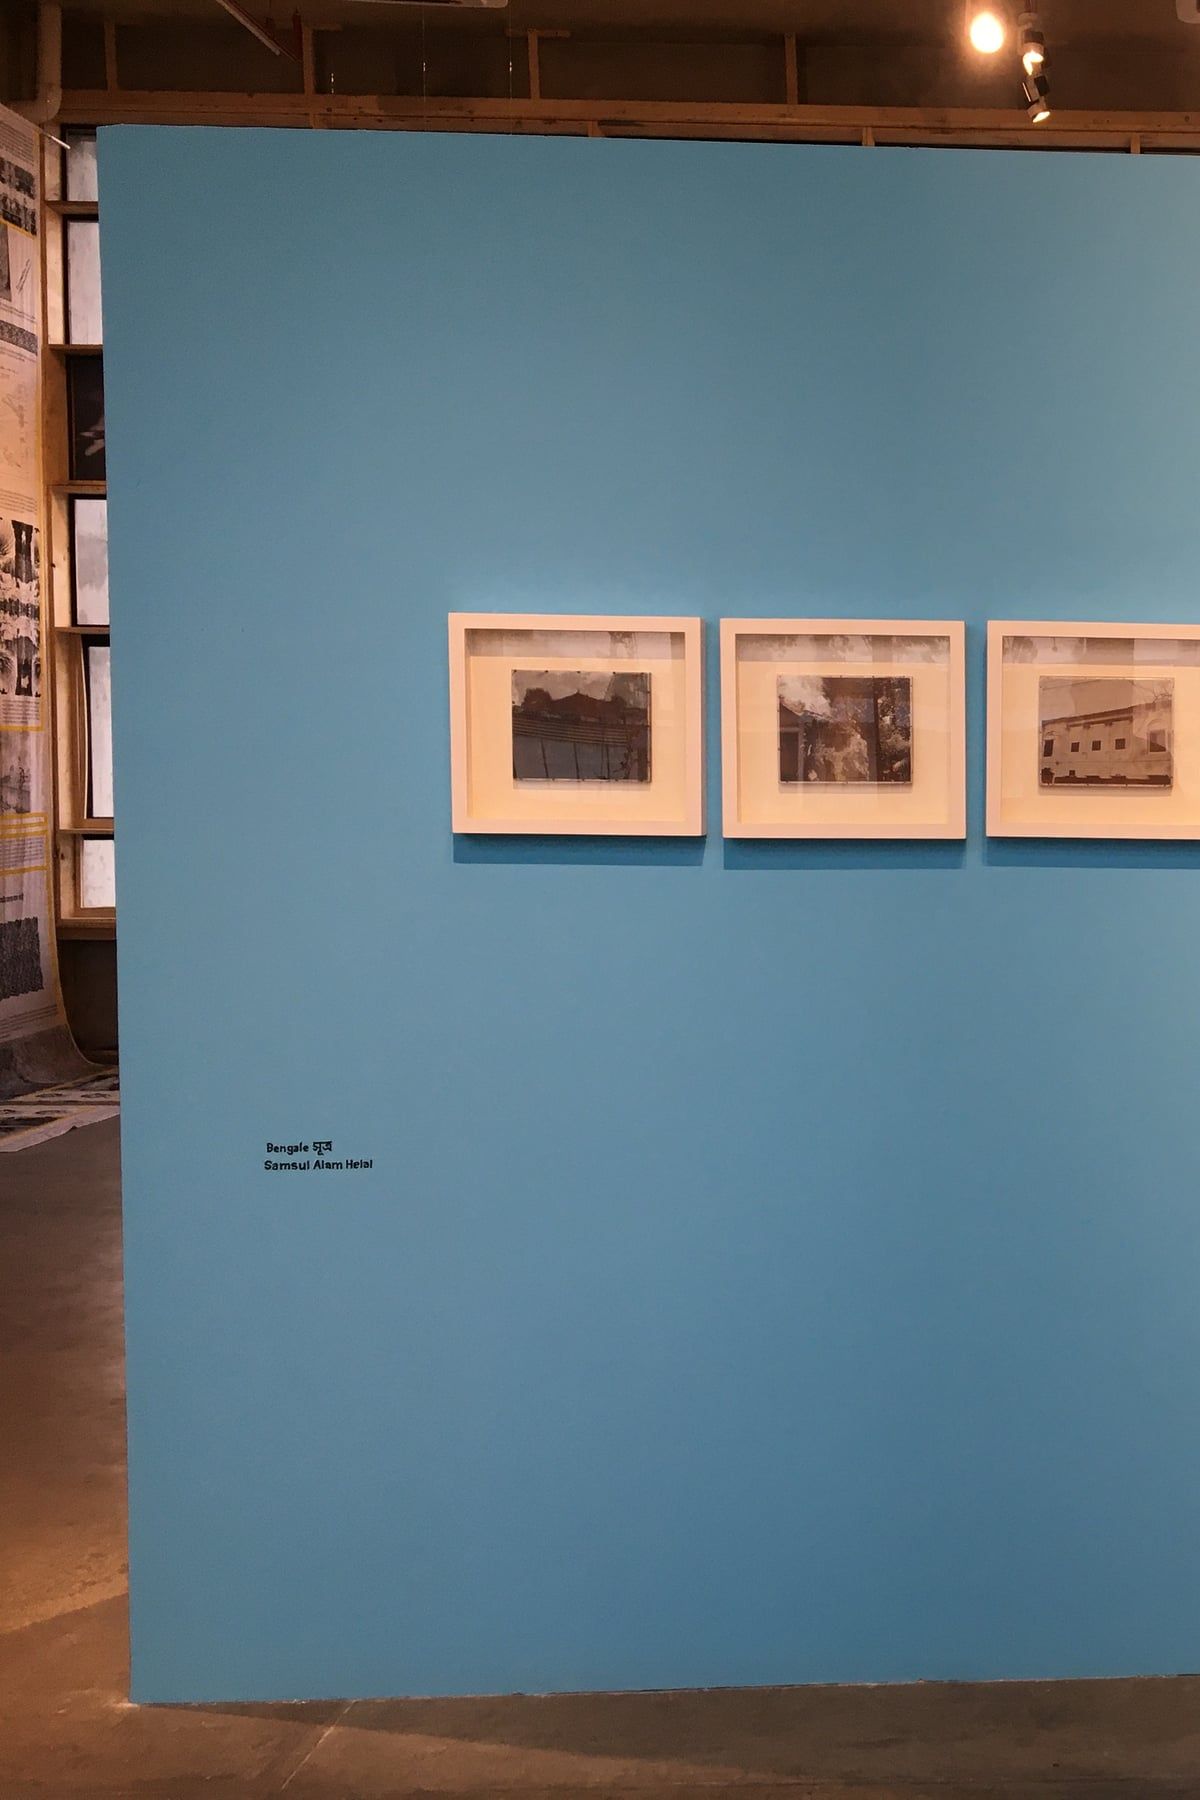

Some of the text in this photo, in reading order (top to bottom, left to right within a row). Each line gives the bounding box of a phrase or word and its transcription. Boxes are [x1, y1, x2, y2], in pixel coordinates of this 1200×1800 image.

[266, 1142, 309, 1155] Bengale
[264, 1159, 373, 1170] Samsul Alam Helal
